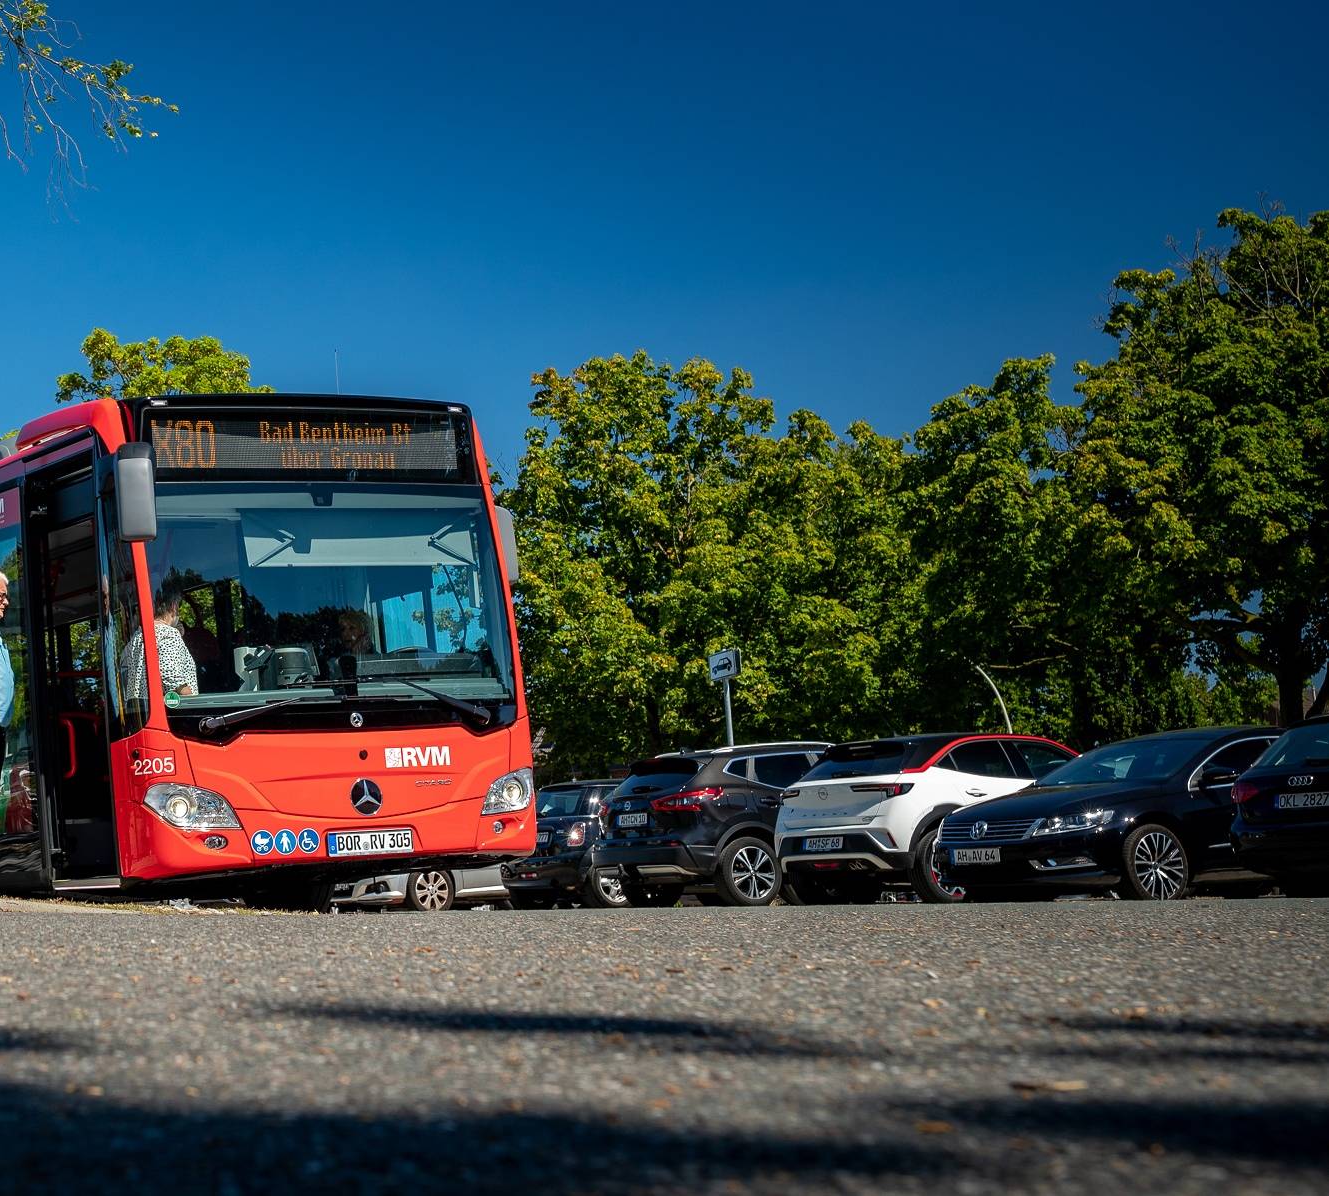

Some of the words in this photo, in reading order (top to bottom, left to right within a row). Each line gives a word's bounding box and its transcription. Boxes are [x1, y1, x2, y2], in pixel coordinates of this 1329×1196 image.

[151, 419, 216, 469] X80
[259, 421, 293, 445] Bad
[299, 421, 387, 446] Bentheim
[330, 448, 397, 469] Gronau
[134, 757, 175, 775] 2205
[402, 746, 451, 767] RVM
[1279, 795, 1299, 807] OKL
[337, 835, 361, 851] BOR
[371, 834, 386, 849] RV
[389, 832, 411, 848] 305
[957, 850, 968, 862] AH
[972, 850, 983, 861] AV
[984, 850, 995, 861] 64
